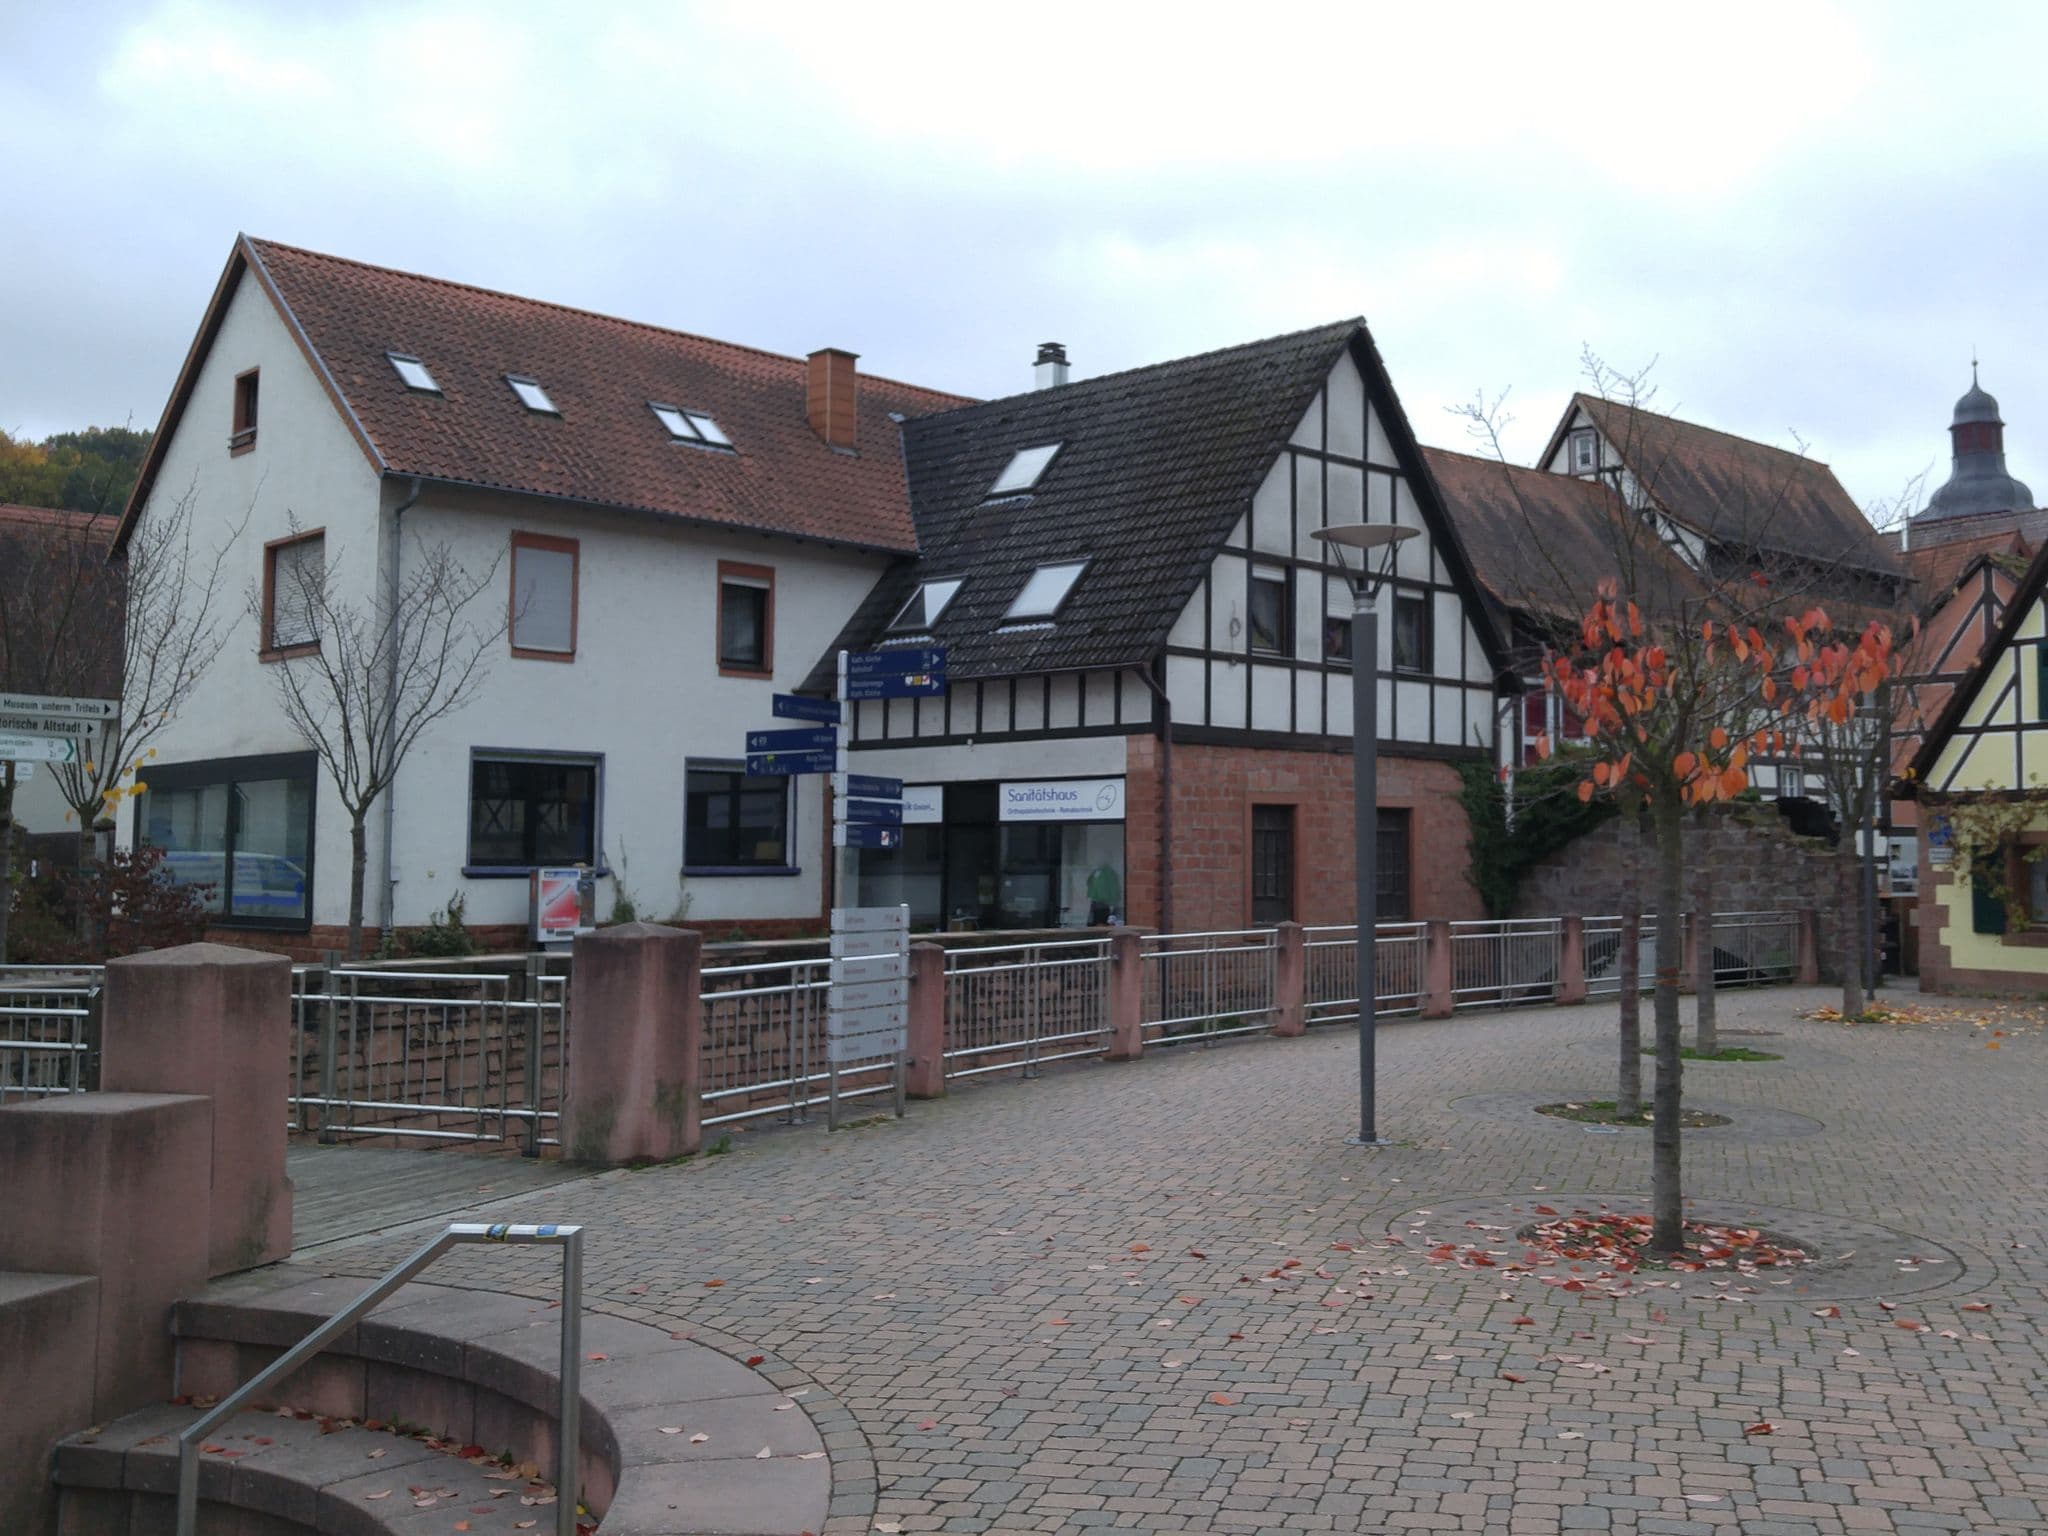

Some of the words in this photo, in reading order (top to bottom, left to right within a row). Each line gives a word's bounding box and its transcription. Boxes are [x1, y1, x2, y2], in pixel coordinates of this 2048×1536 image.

[3, 698, 38, 710] Museum
[41, 701, 71, 712] unterm
[75, 702, 100, 713] Trifels
[43, 719, 81, 733] Altstadt
[1008, 788, 1078, 802] Sanitätshaus
